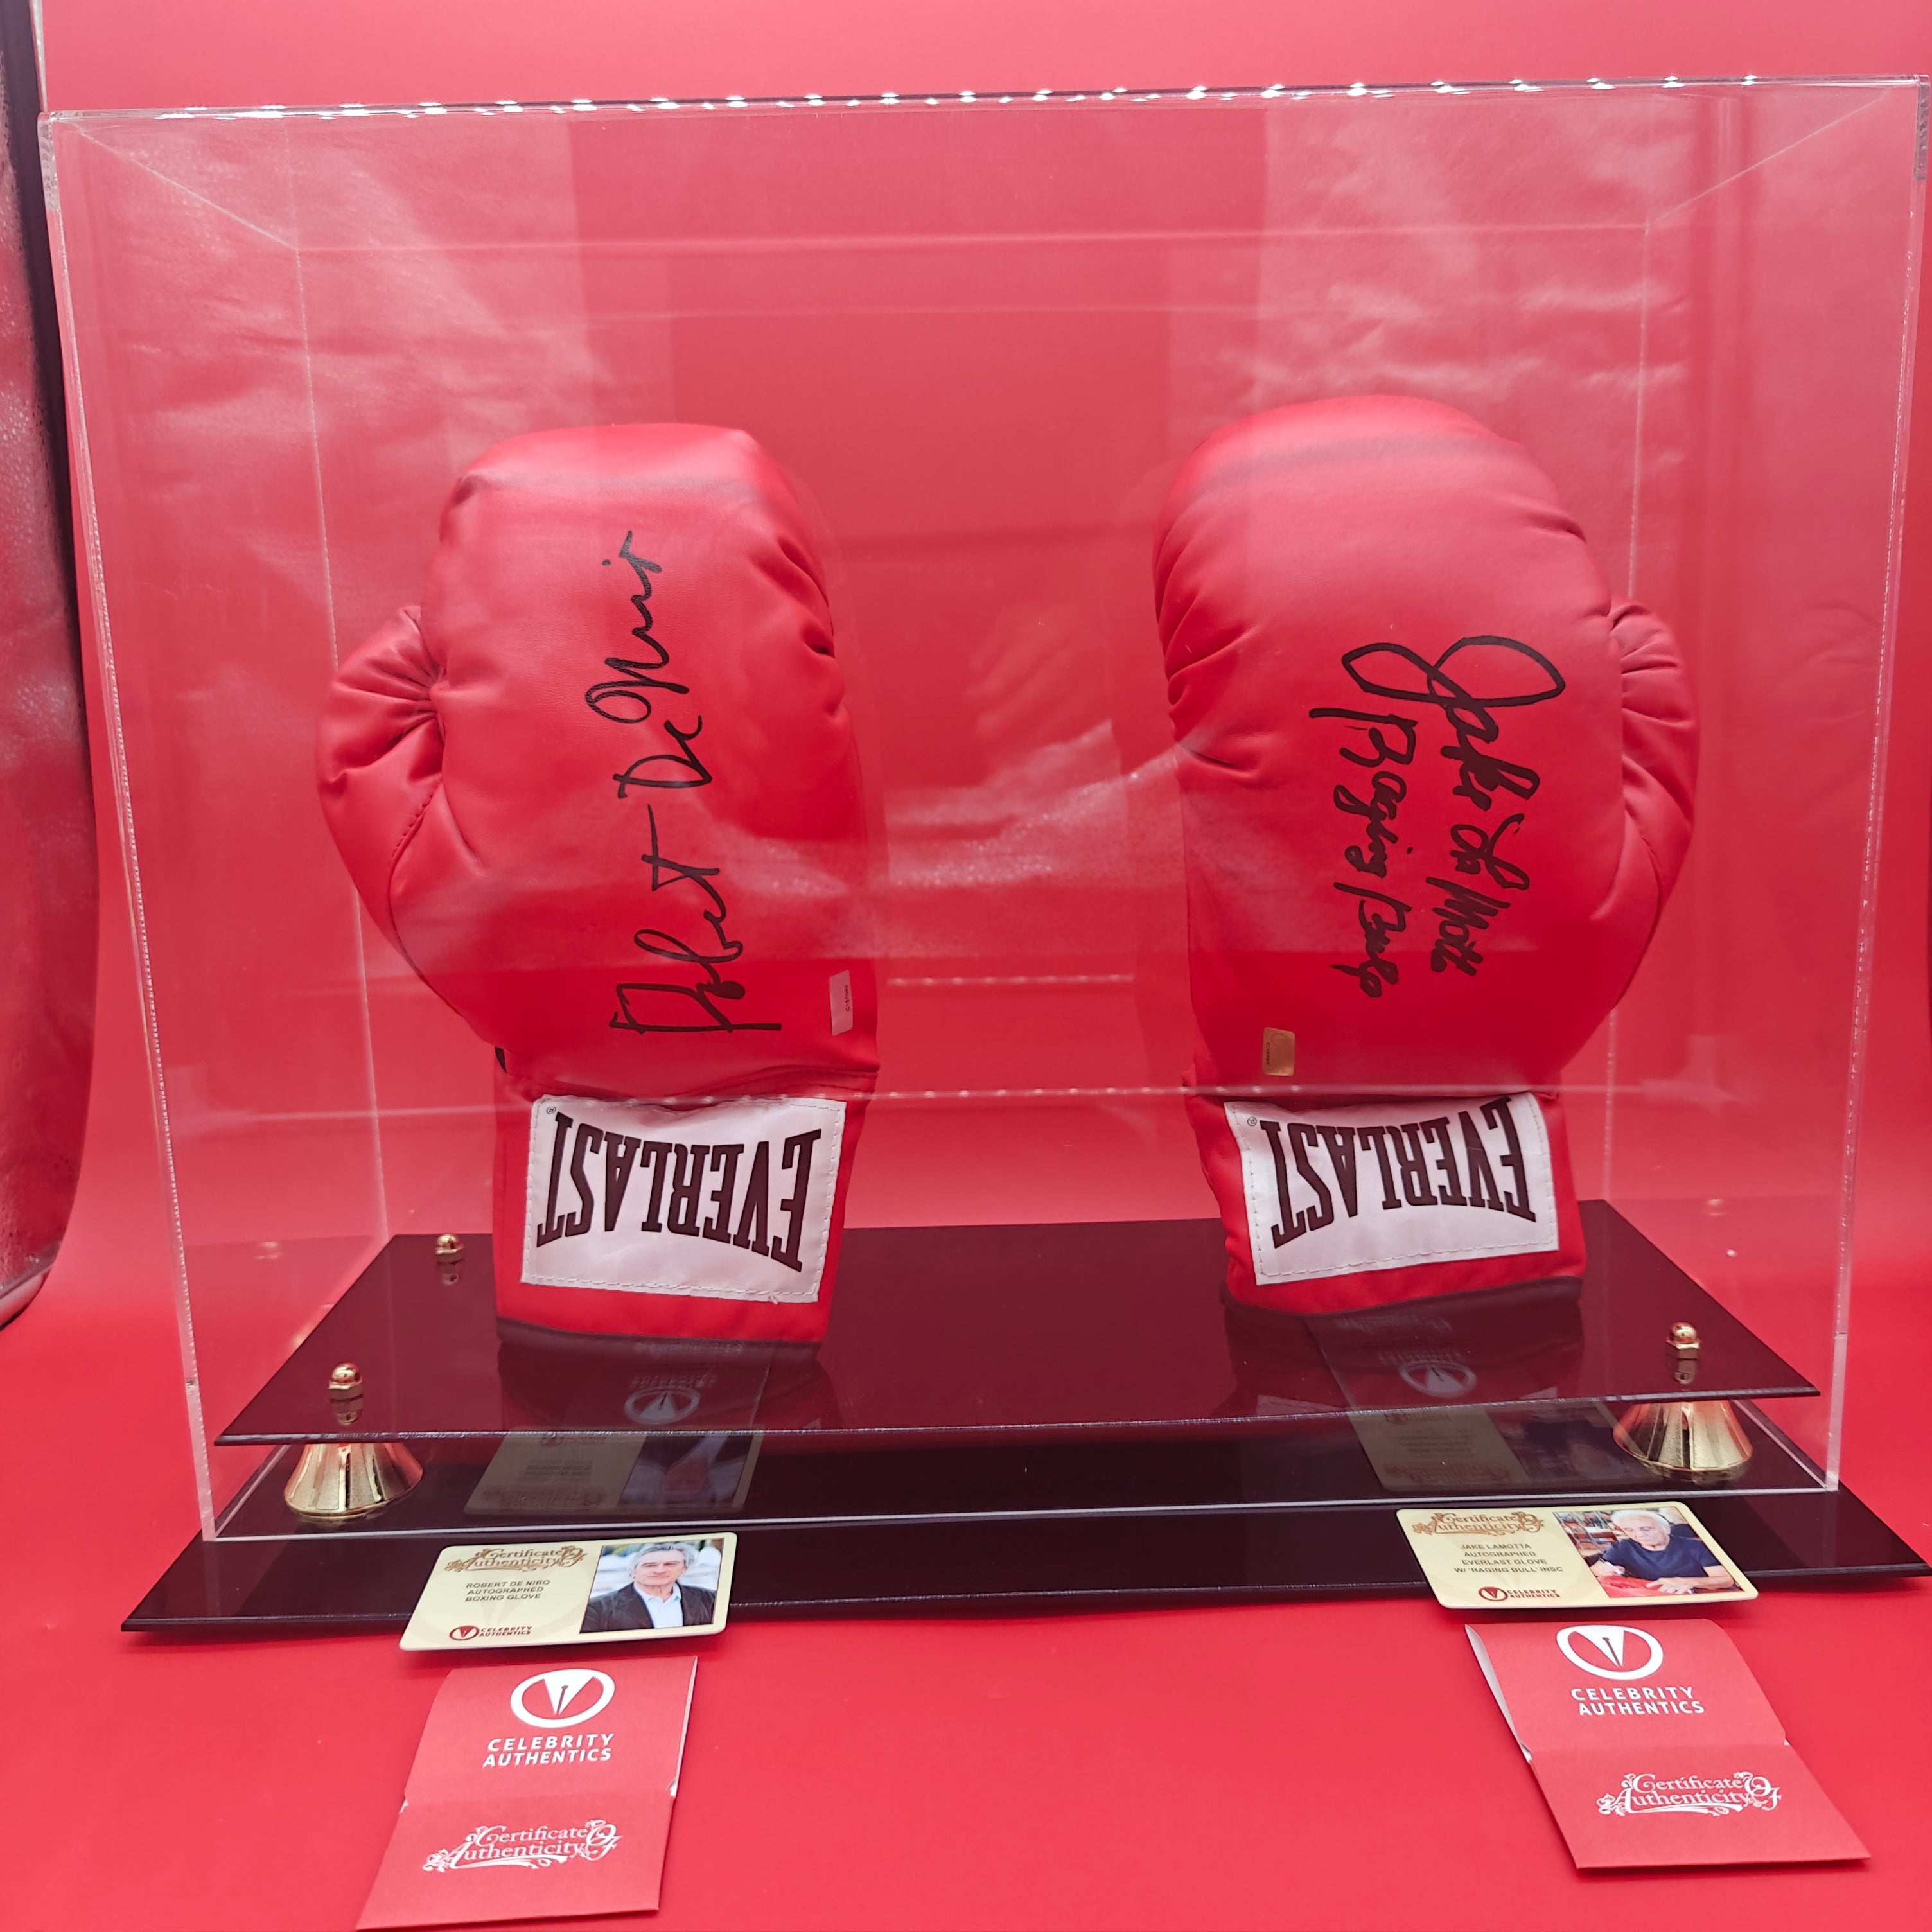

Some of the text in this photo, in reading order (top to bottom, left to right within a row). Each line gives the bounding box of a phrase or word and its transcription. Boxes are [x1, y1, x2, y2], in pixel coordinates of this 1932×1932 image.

[1259, 1096, 1537, 1249] EVERLAST
[536, 1111, 822, 1273] EVERLAST
[1412, 1520, 1521, 1536] Authenticity
[1432, 1512, 1518, 1524] Certificate
[475, 1548, 563, 1559] Certificate
[444, 1556, 563, 1572] Authenticity
[466, 1586, 545, 1595] AUTOGRAPHED
[1570, 1685, 1694, 1701] CELEBRITY
[1578, 1700, 1705, 1716] AUTHENTICS
[486, 1732, 615, 1752] CELEBRITY
[482, 1747, 612, 1768] AUTHENTICS
[1620, 1773, 1744, 1793] Certificate
[1595, 1787, 1751, 1817] Authenticity
[465, 1825, 588, 1847] Certificate
[421, 1841, 584, 1874] Authenticity
